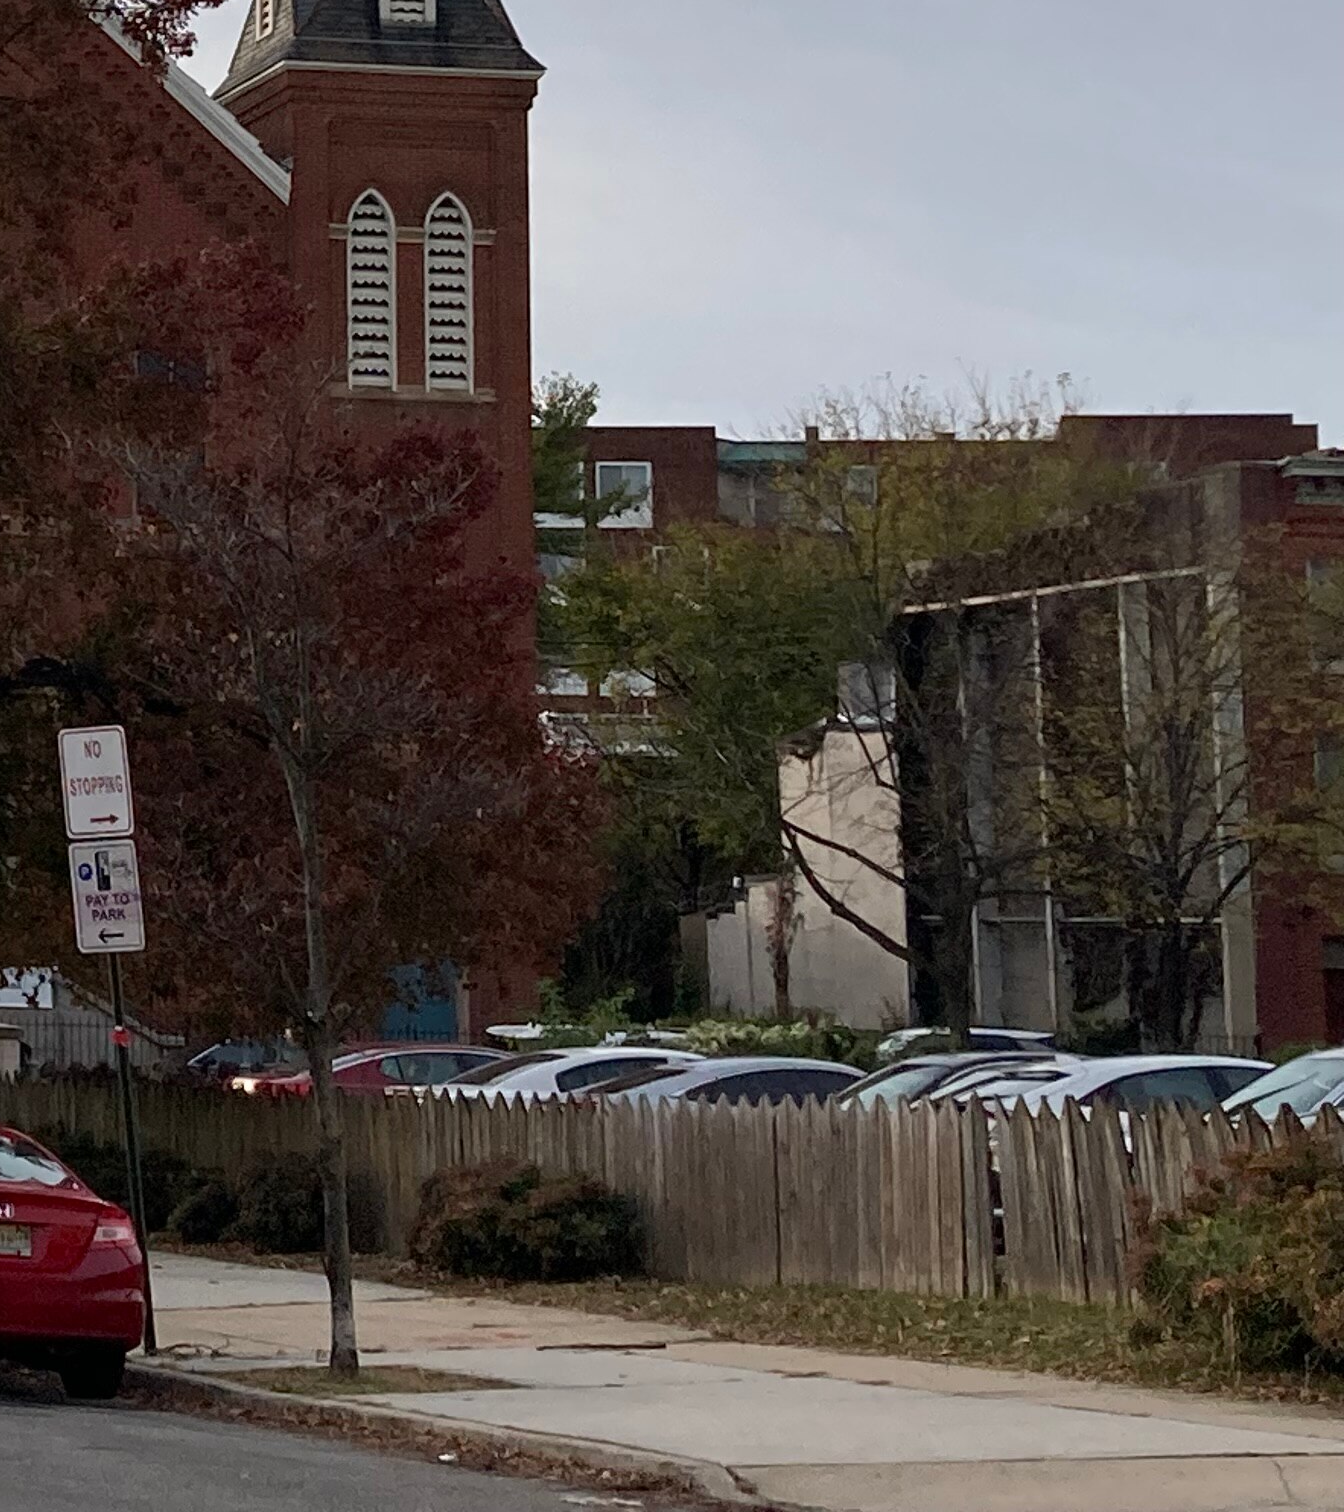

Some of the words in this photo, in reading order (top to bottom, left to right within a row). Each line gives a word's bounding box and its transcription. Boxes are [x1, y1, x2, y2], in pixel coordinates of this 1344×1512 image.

[83, 740, 102, 759] NO
[69, 774, 123, 797] STOPPING
[85, 893, 109, 908] PAY
[111, 892, 130, 906] TO
[91, 908, 126, 922] PARK
